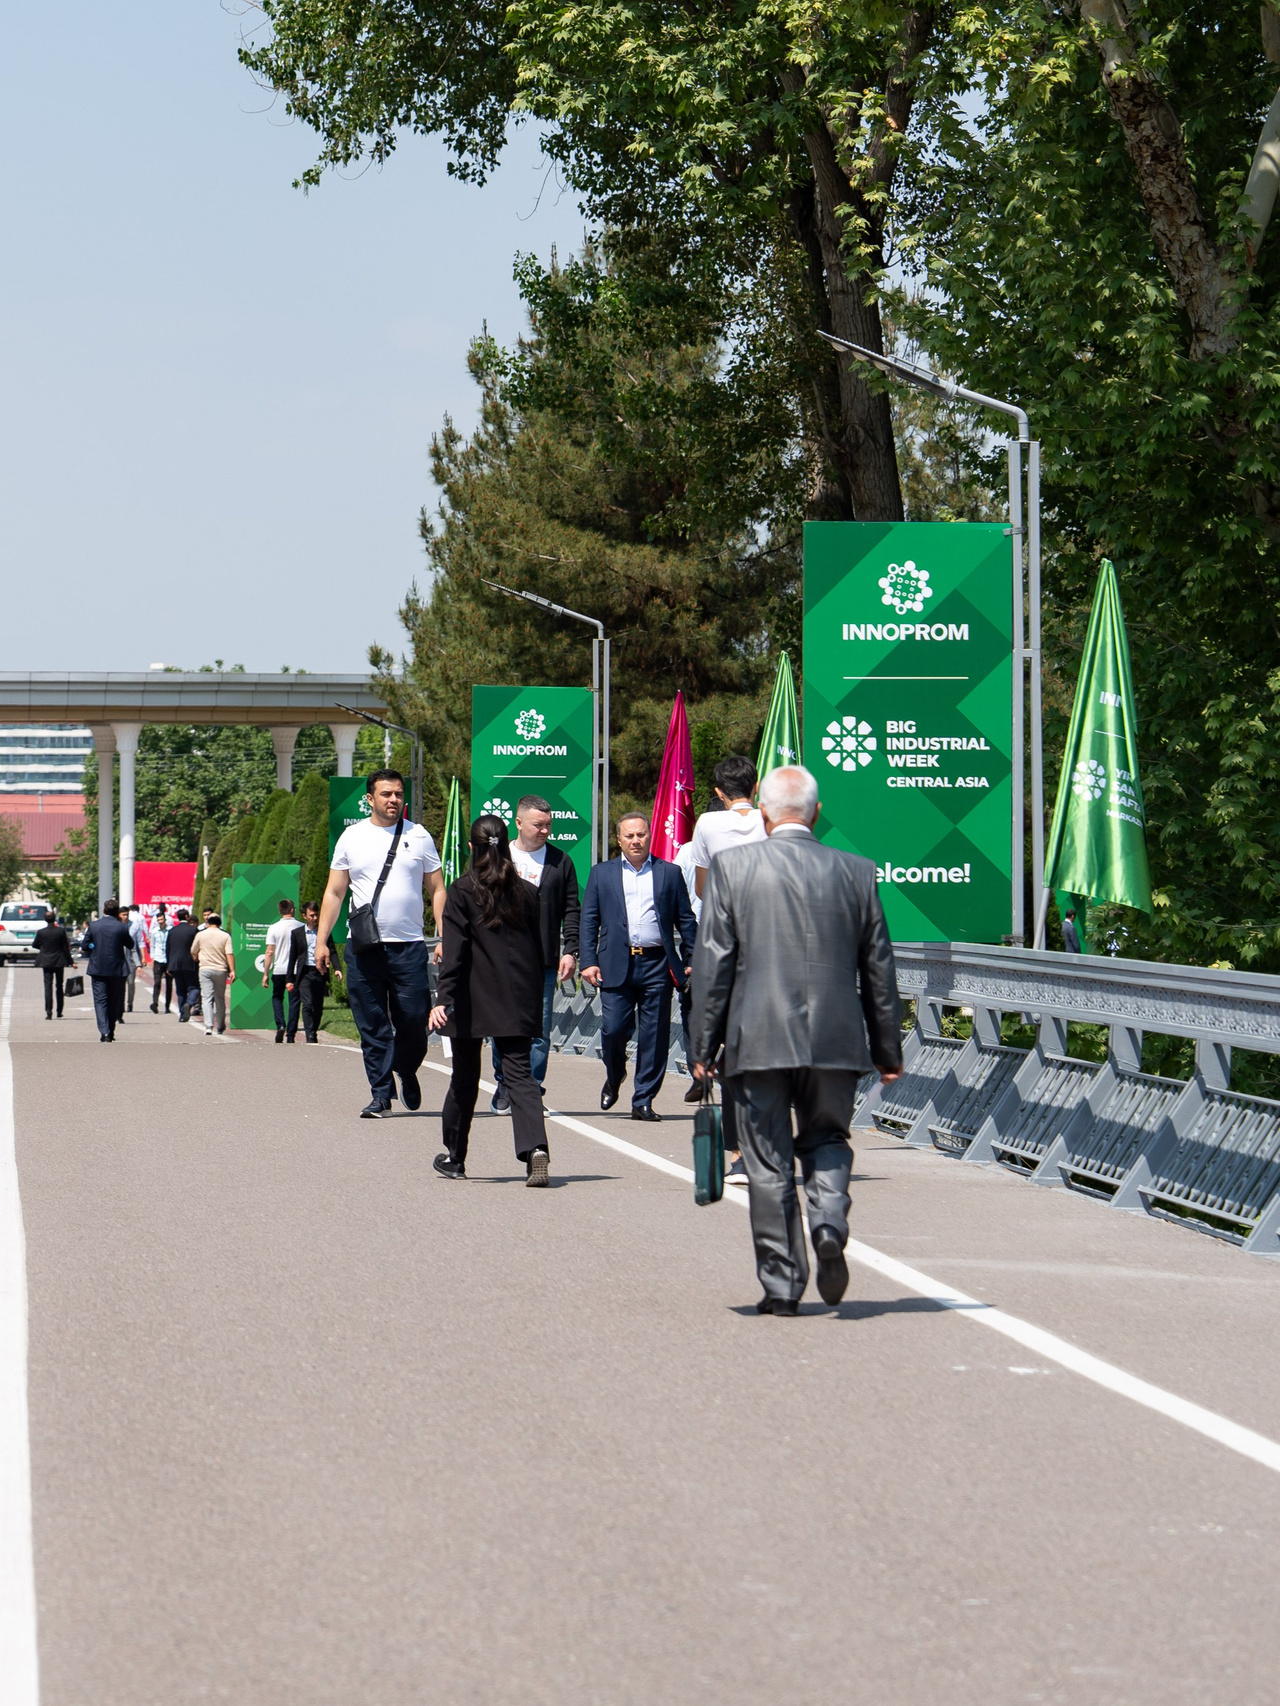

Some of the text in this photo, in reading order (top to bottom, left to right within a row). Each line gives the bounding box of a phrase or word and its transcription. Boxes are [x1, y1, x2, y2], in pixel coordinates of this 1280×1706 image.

[842, 623, 969, 641] INNOPROM
[886, 720, 917, 734] BIG
[493, 744, 567, 756] INNOPROM
[886, 737, 991, 751] INDUSTRIAL
[886, 754, 940, 768] WEEK
[886, 776, 990, 788] CENTRAL ASIA
[551, 810, 579, 819] TRIAL
[557, 833, 578, 841] ASIA
[876, 862, 971, 883] elcome!
